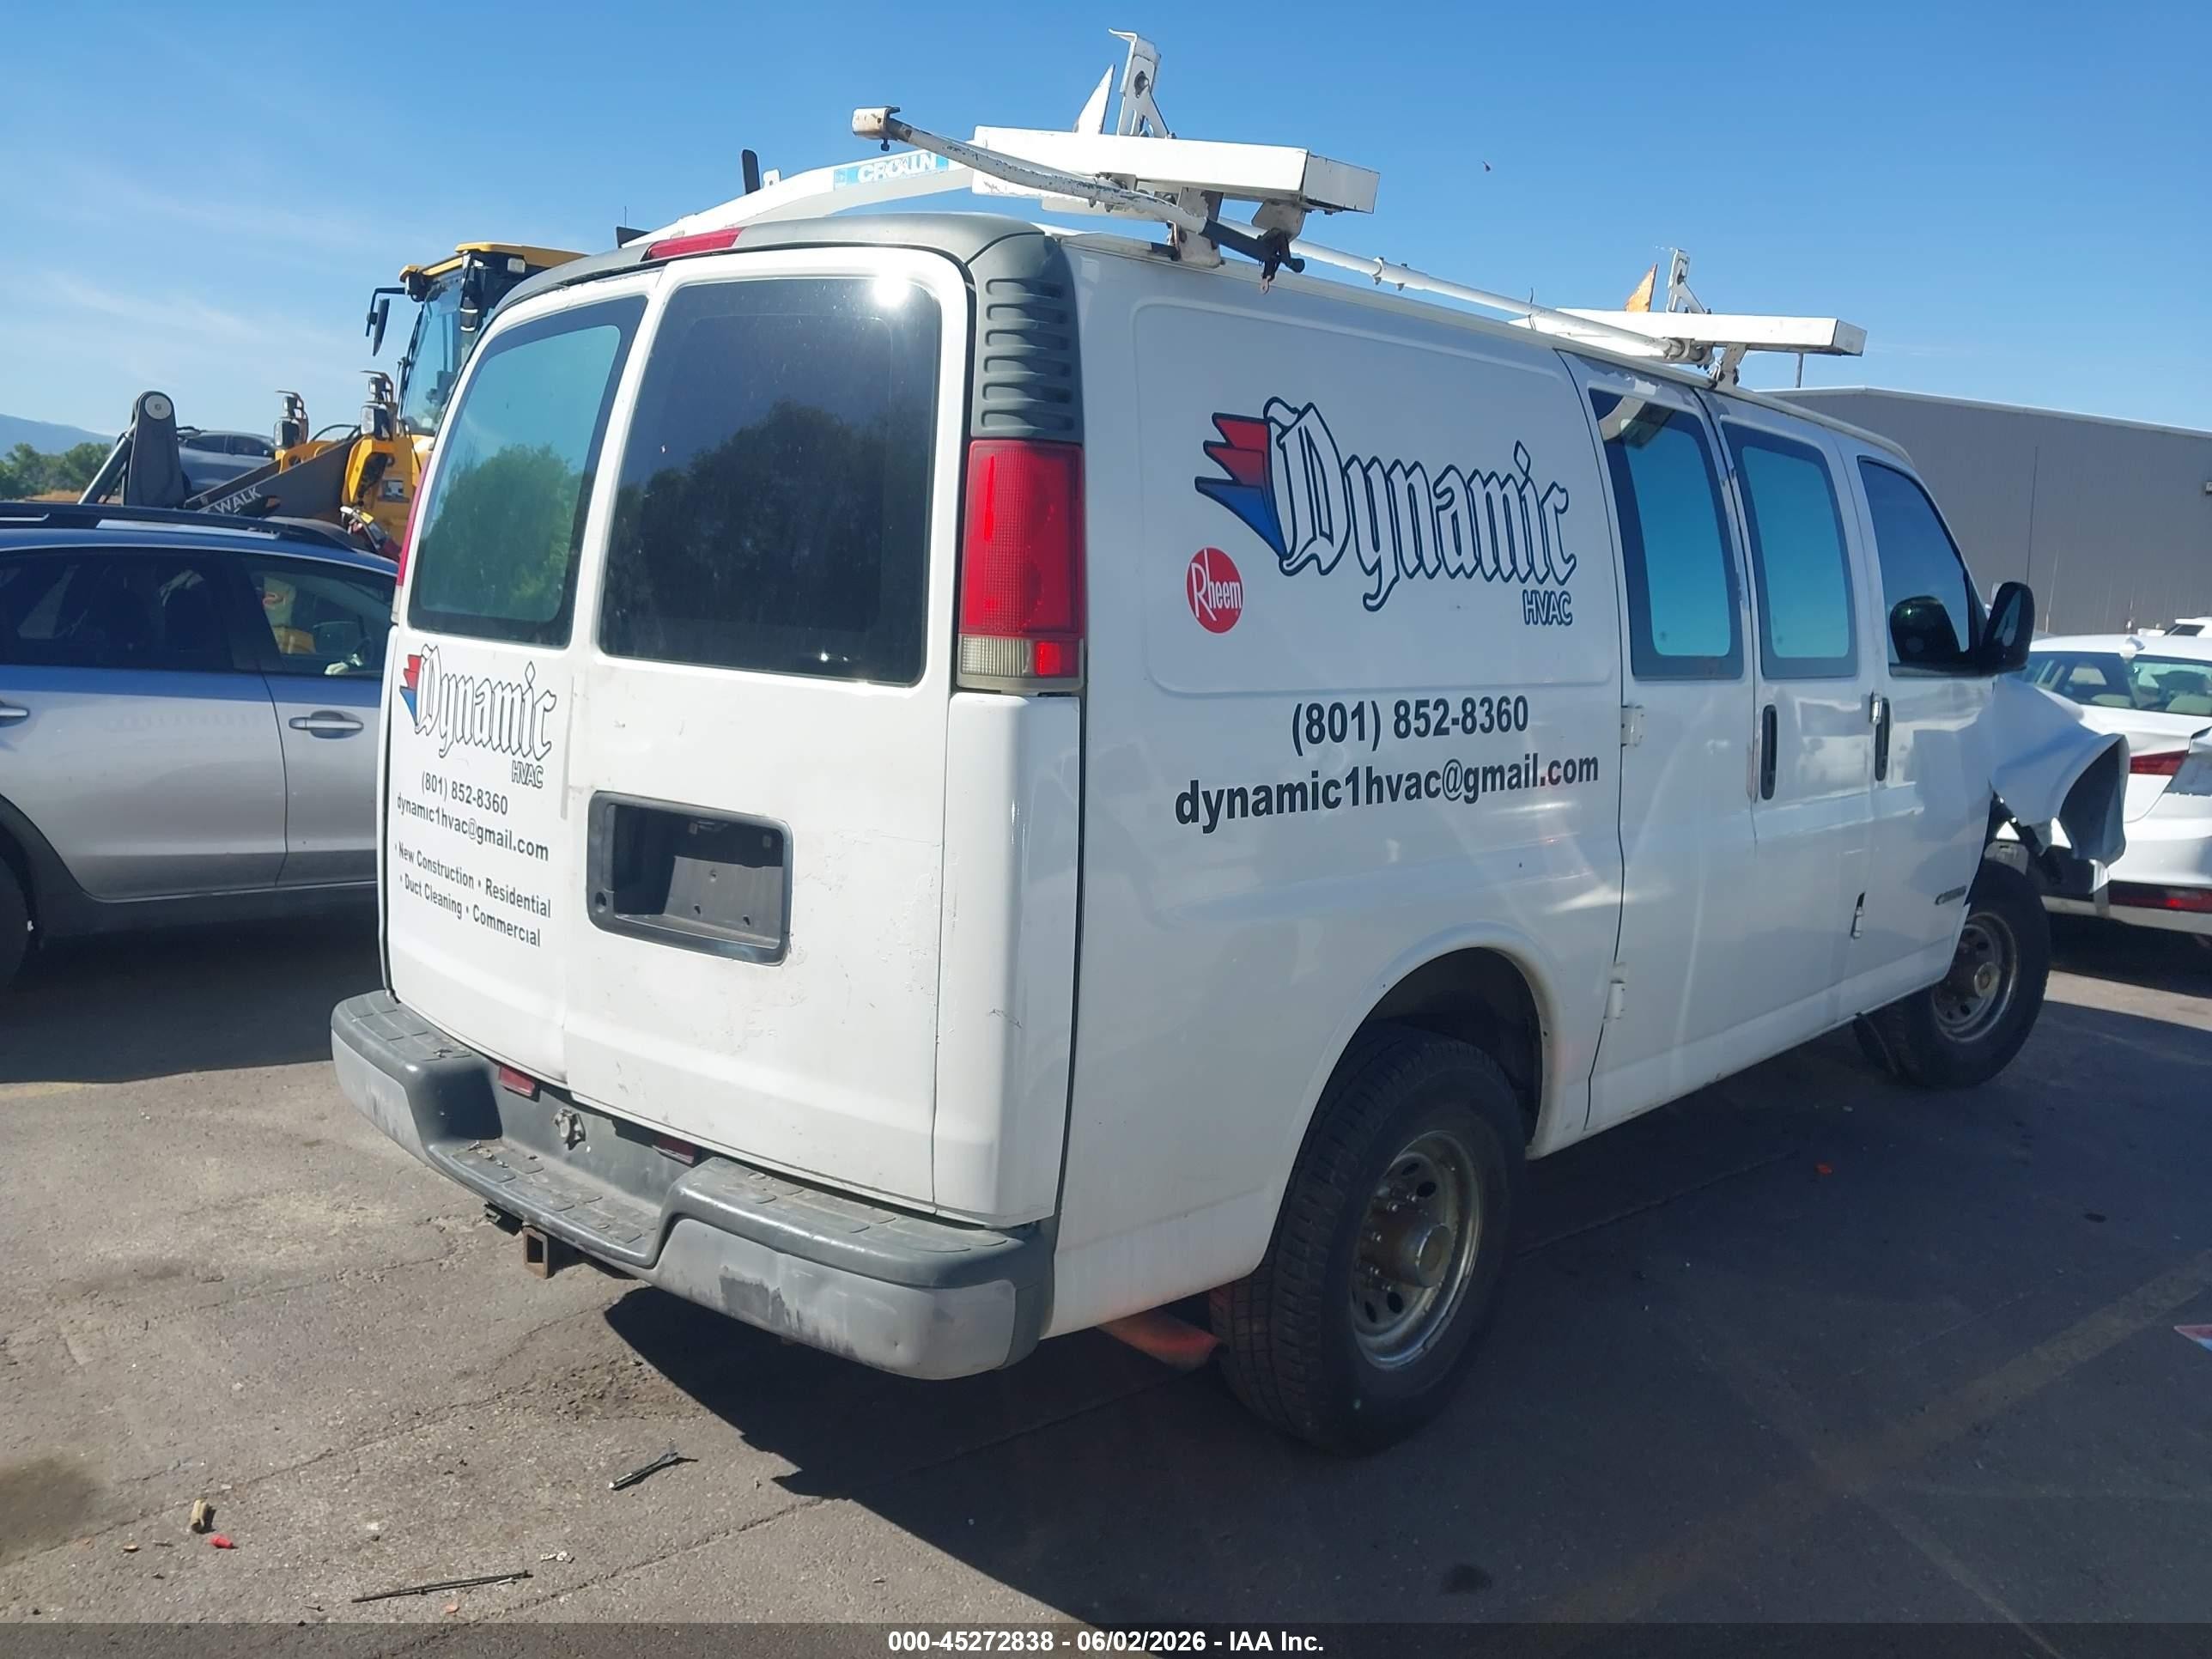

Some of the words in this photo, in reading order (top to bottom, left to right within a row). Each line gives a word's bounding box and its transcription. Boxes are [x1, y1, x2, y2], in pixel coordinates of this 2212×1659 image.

[215, 487, 262, 514] WALK
[1264, 396, 1577, 612] Dynamic
[1191, 549, 1242, 622] Rheem
[1522, 589, 1573, 626] HVAC
[415, 644, 556, 761] Dynamic
[1291, 700, 1382, 756] (801)
[1393, 695, 1529, 738] 852-8360
[422, 770, 448, 802] (801)
[451, 781, 508, 816] 852-8360
[511, 760, 544, 789] HVAC
[1175, 753, 1599, 834] dynamic1hvac@gmail.com
[397, 791, 550, 861] dynamic1hvac@gmail.com
[398, 840, 415, 863] New
[416, 849, 475, 890] Construction
[485, 878, 551, 919] Residential
[404, 872, 422, 897] Duct
[424, 882, 464, 921] Cleaning
[472, 904, 541, 948] Commercial
